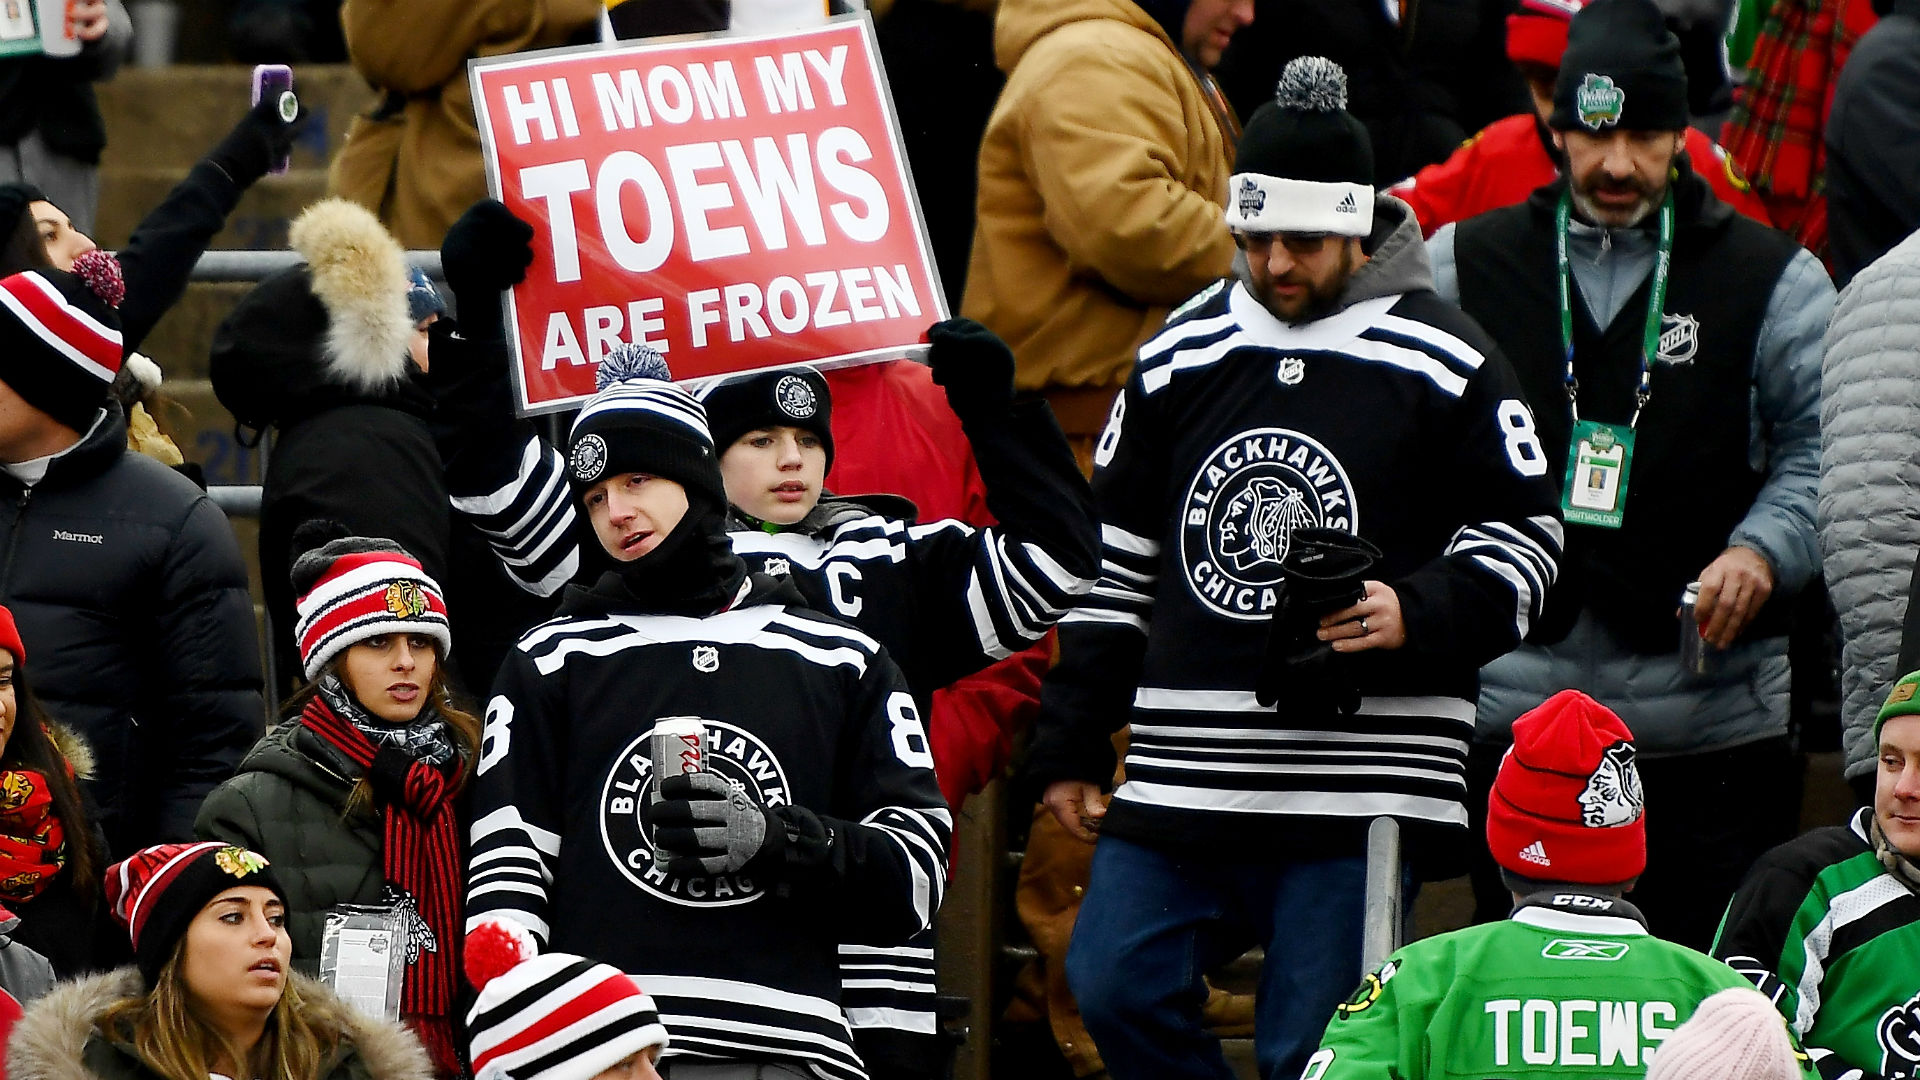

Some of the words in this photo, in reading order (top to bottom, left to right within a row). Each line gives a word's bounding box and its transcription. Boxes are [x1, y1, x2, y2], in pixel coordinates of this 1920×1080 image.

[503, 78, 580, 144] HI
[592, 60, 747, 131] MOM
[755, 45, 848, 114] MY
[519, 126, 890, 283] TOEWS
[542, 297, 669, 370] ARE
[688, 264, 922, 348] FROZEN
[1660, 325, 1691, 353] NHL
[1095, 388, 1126, 467] 8
[1497, 399, 1548, 476] 8
[1187, 436, 1349, 530] BLACKHAWKS
[53, 529, 104, 544] Marmot
[825, 561, 863, 618] C
[1193, 560, 1277, 611] CHICA
[886, 691, 935, 769] 8
[610, 728, 787, 814] BLAHAWK
[627, 848, 756, 898] CHICAG
[1519, 851, 1550, 867] adidas
[1552, 894, 1614, 911] CCM
[1484, 999, 1677, 1067] TOEWS
